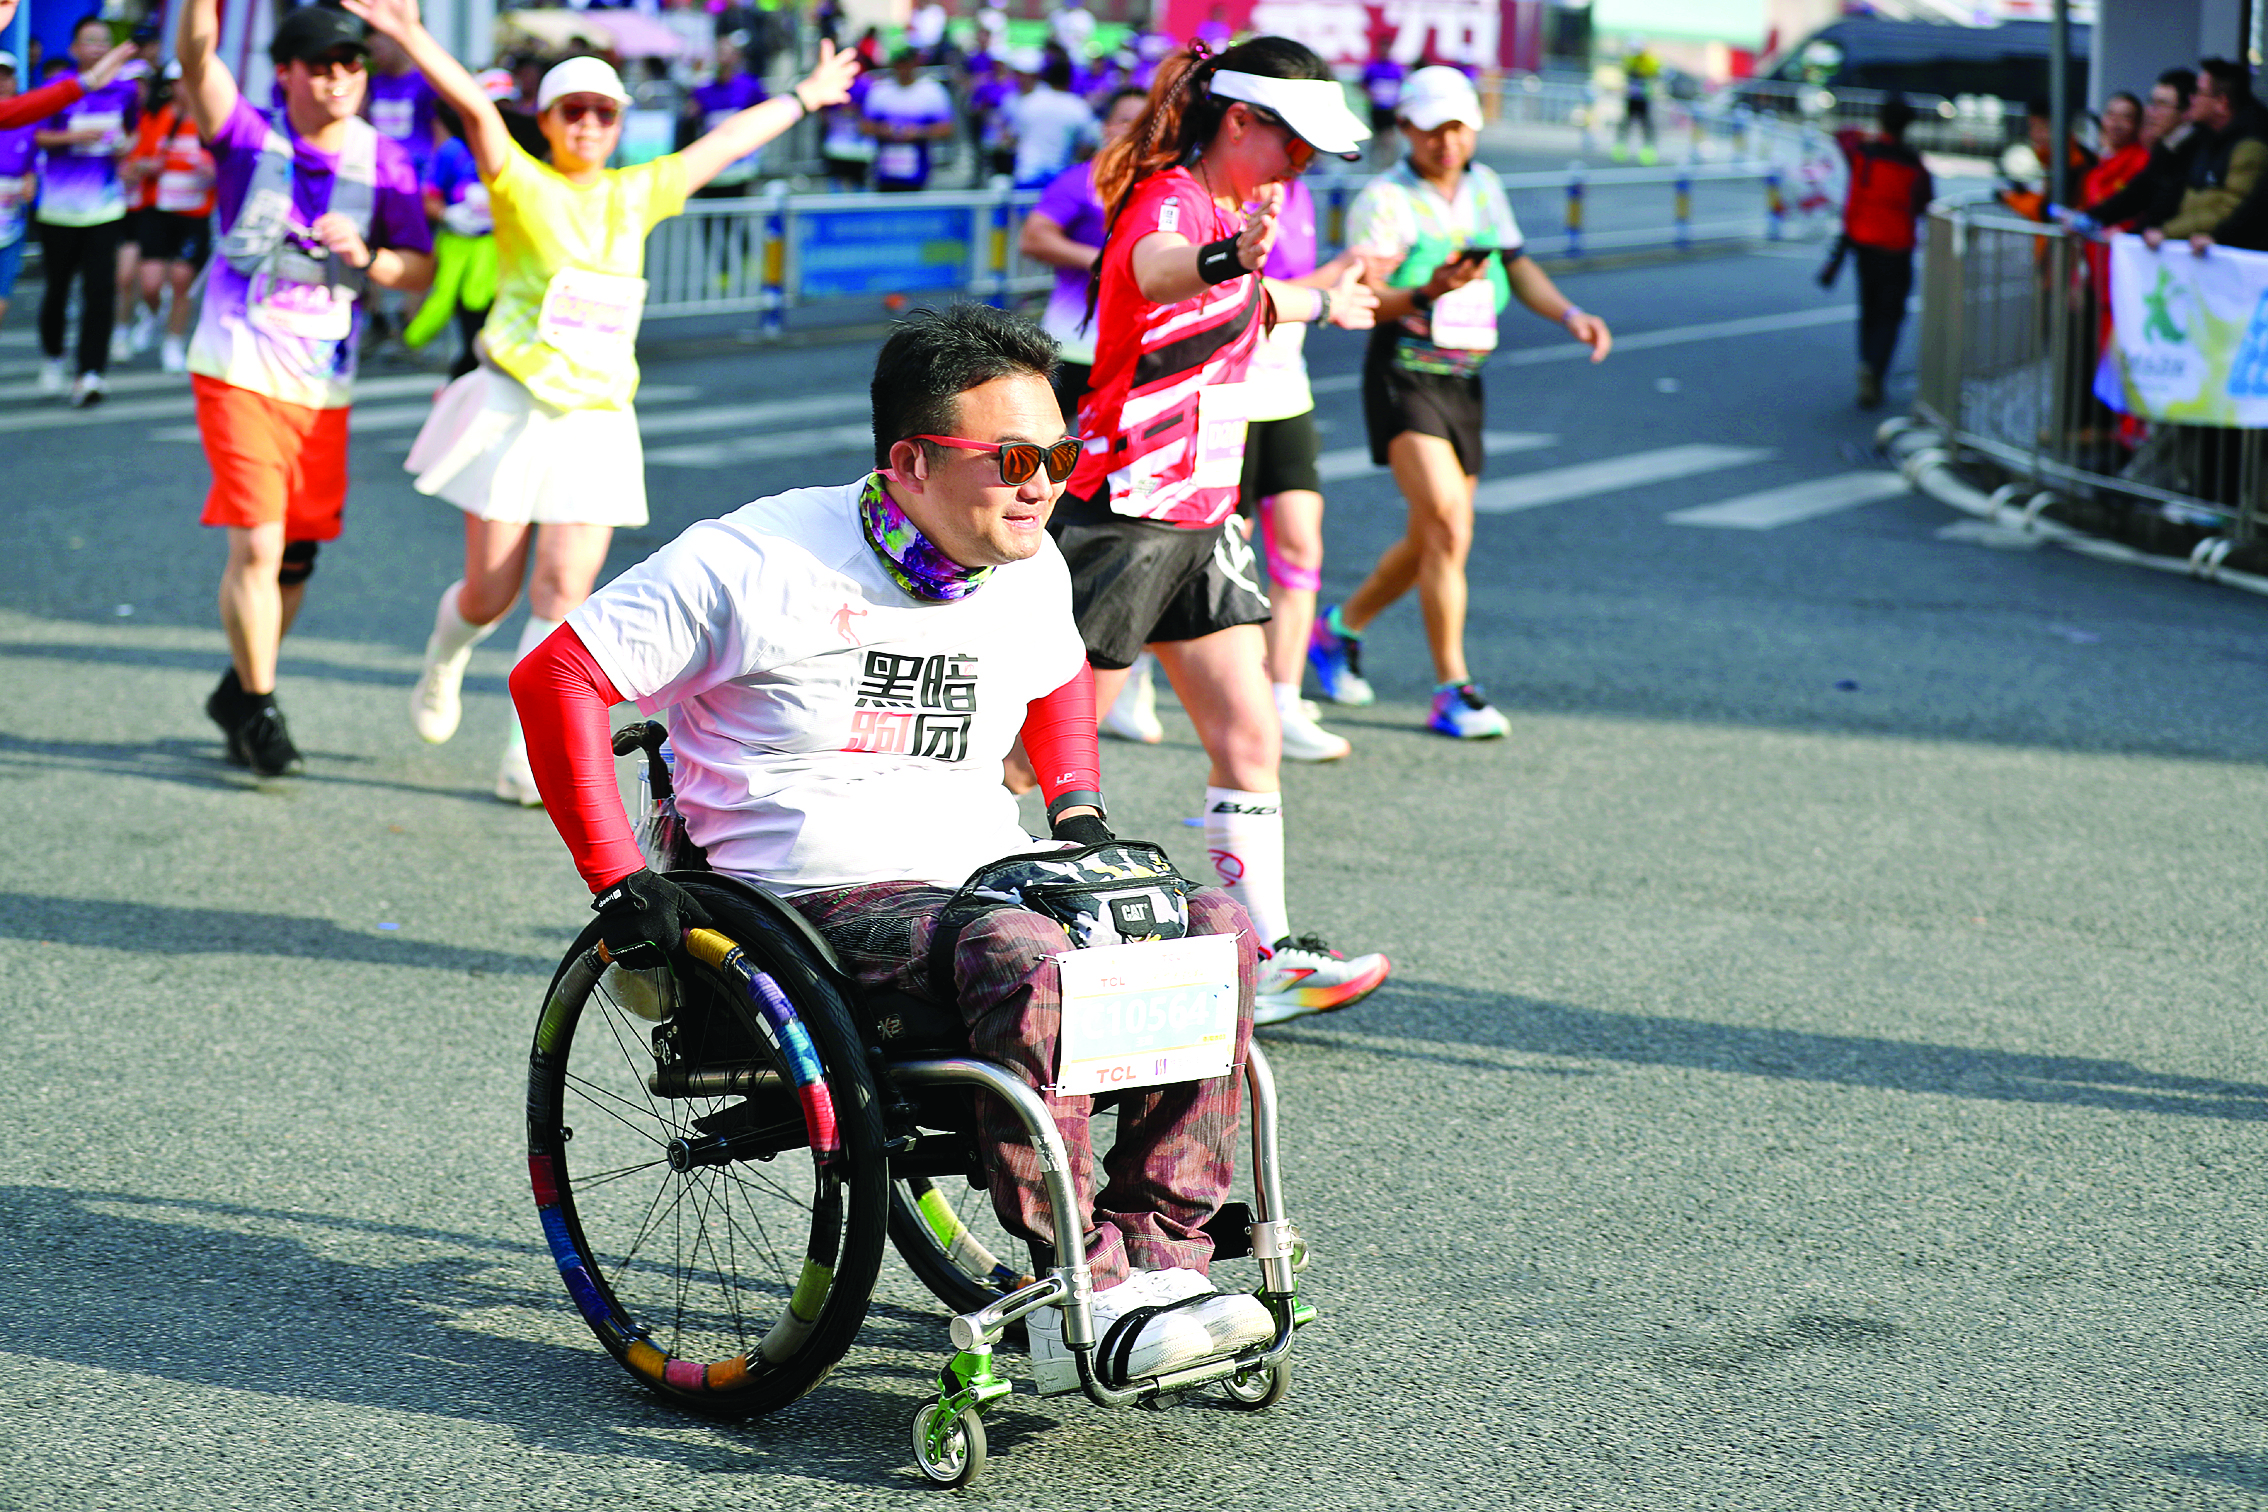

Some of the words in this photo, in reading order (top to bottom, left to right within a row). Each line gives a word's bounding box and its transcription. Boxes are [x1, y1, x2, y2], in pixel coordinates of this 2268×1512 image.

[854, 650, 979, 712] 黑暗
[1056, 772, 1074, 785] LP
[1121, 903, 1147, 922] CAT
[1100, 976, 1126, 988] TCL
[1081, 991, 1210, 1040] C10564
[1096, 1066, 1137, 1084] TCL
